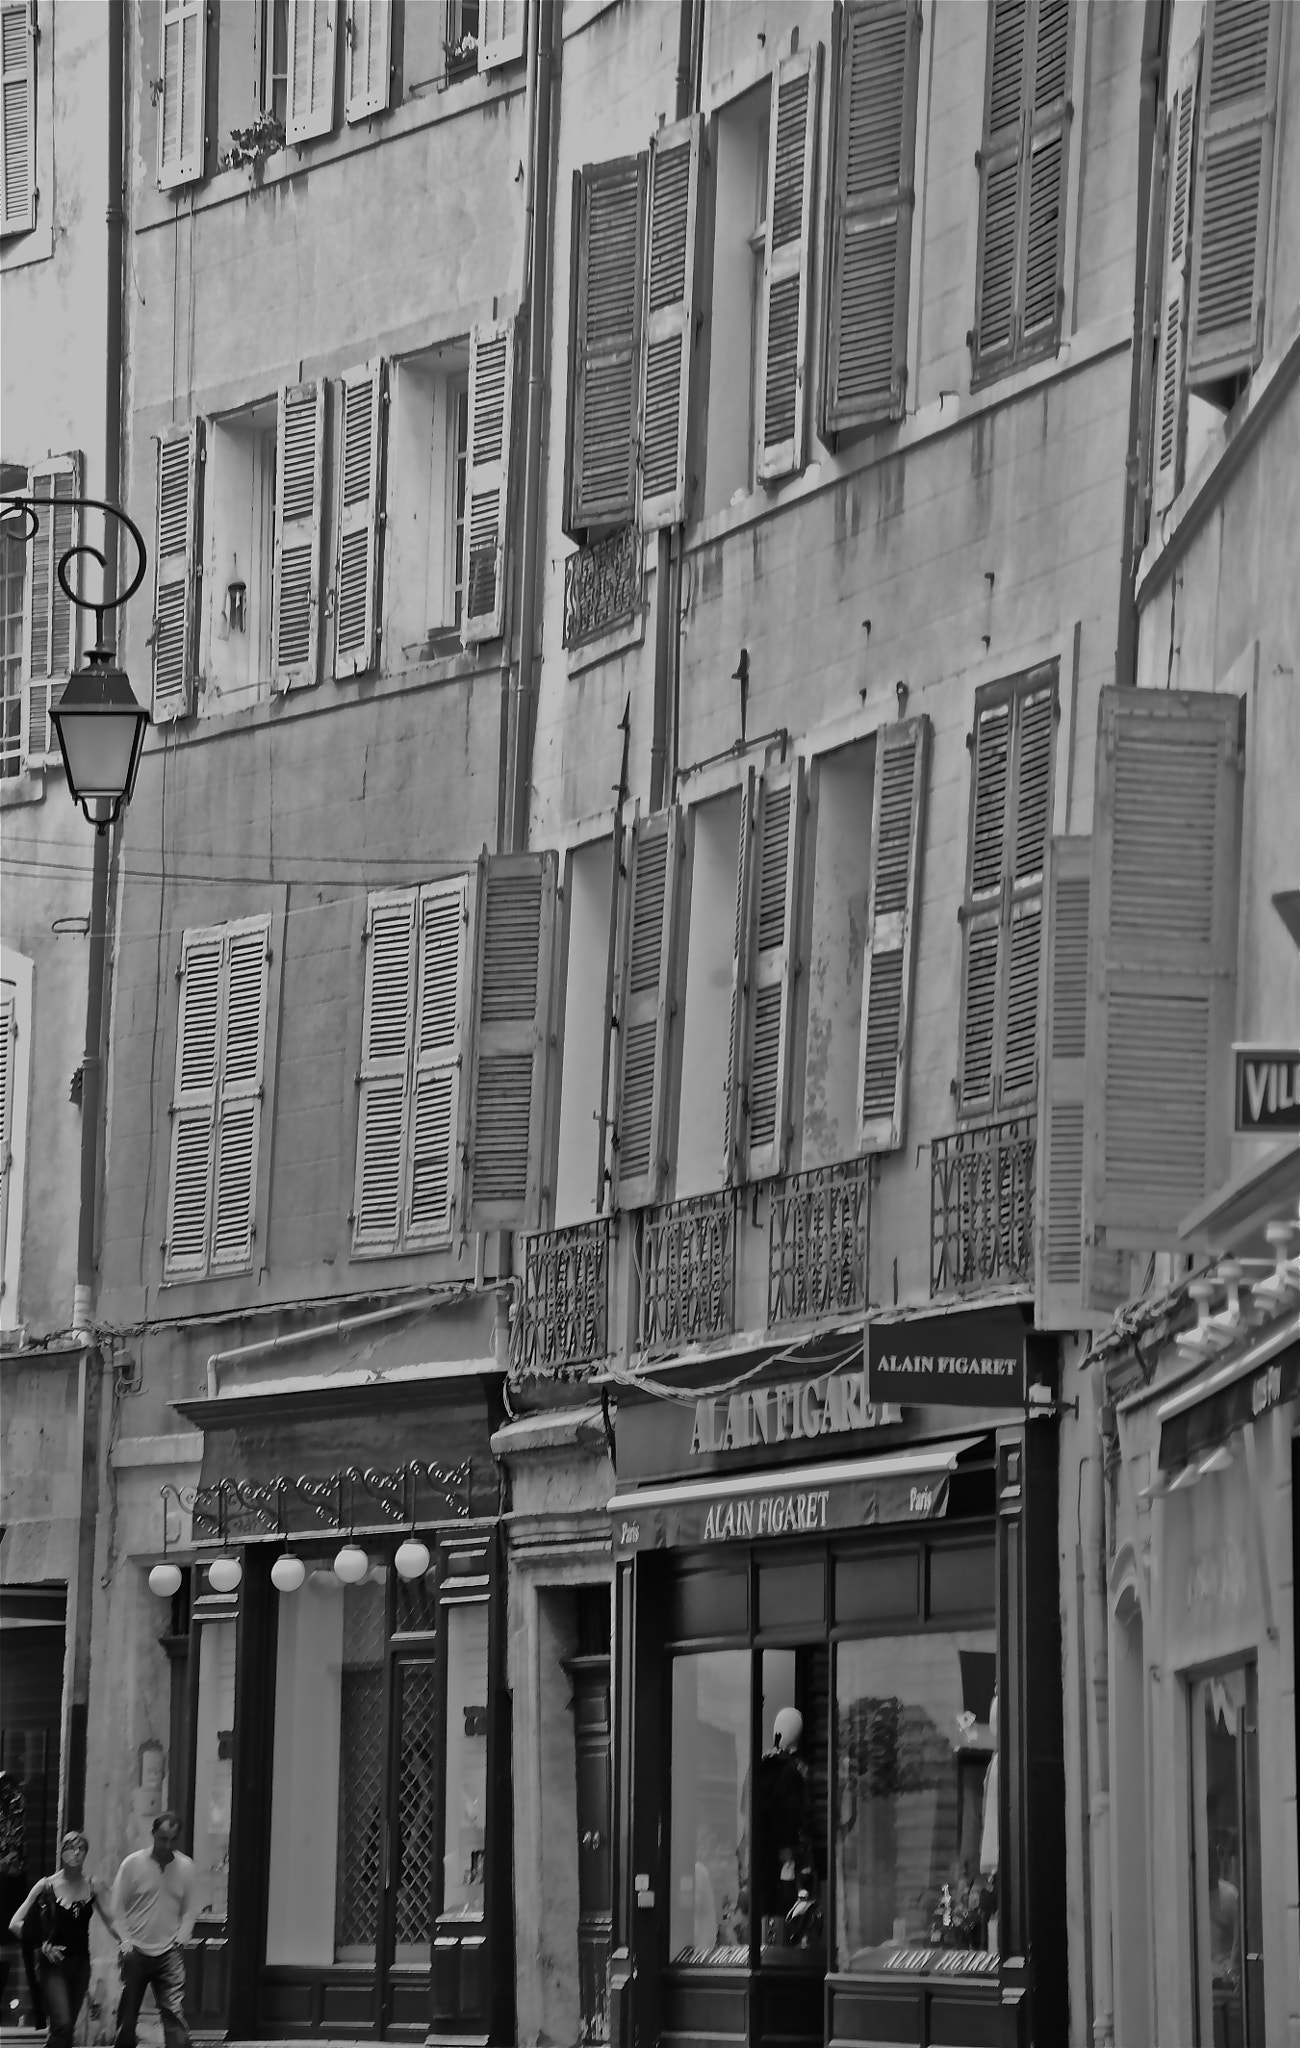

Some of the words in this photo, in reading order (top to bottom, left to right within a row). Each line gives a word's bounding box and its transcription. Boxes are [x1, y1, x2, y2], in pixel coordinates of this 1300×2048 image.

[877, 1355, 934, 1373] ALAIN
[937, 1356, 1017, 1375] FIGARET
[690, 1388, 770, 1455] ALAIN
[909, 1487, 933, 1511] Paris
[703, 1500, 754, 1540] ALAIN
[756, 1490, 829, 1533] FIGARET
[620, 1521, 640, 1544] Paris
